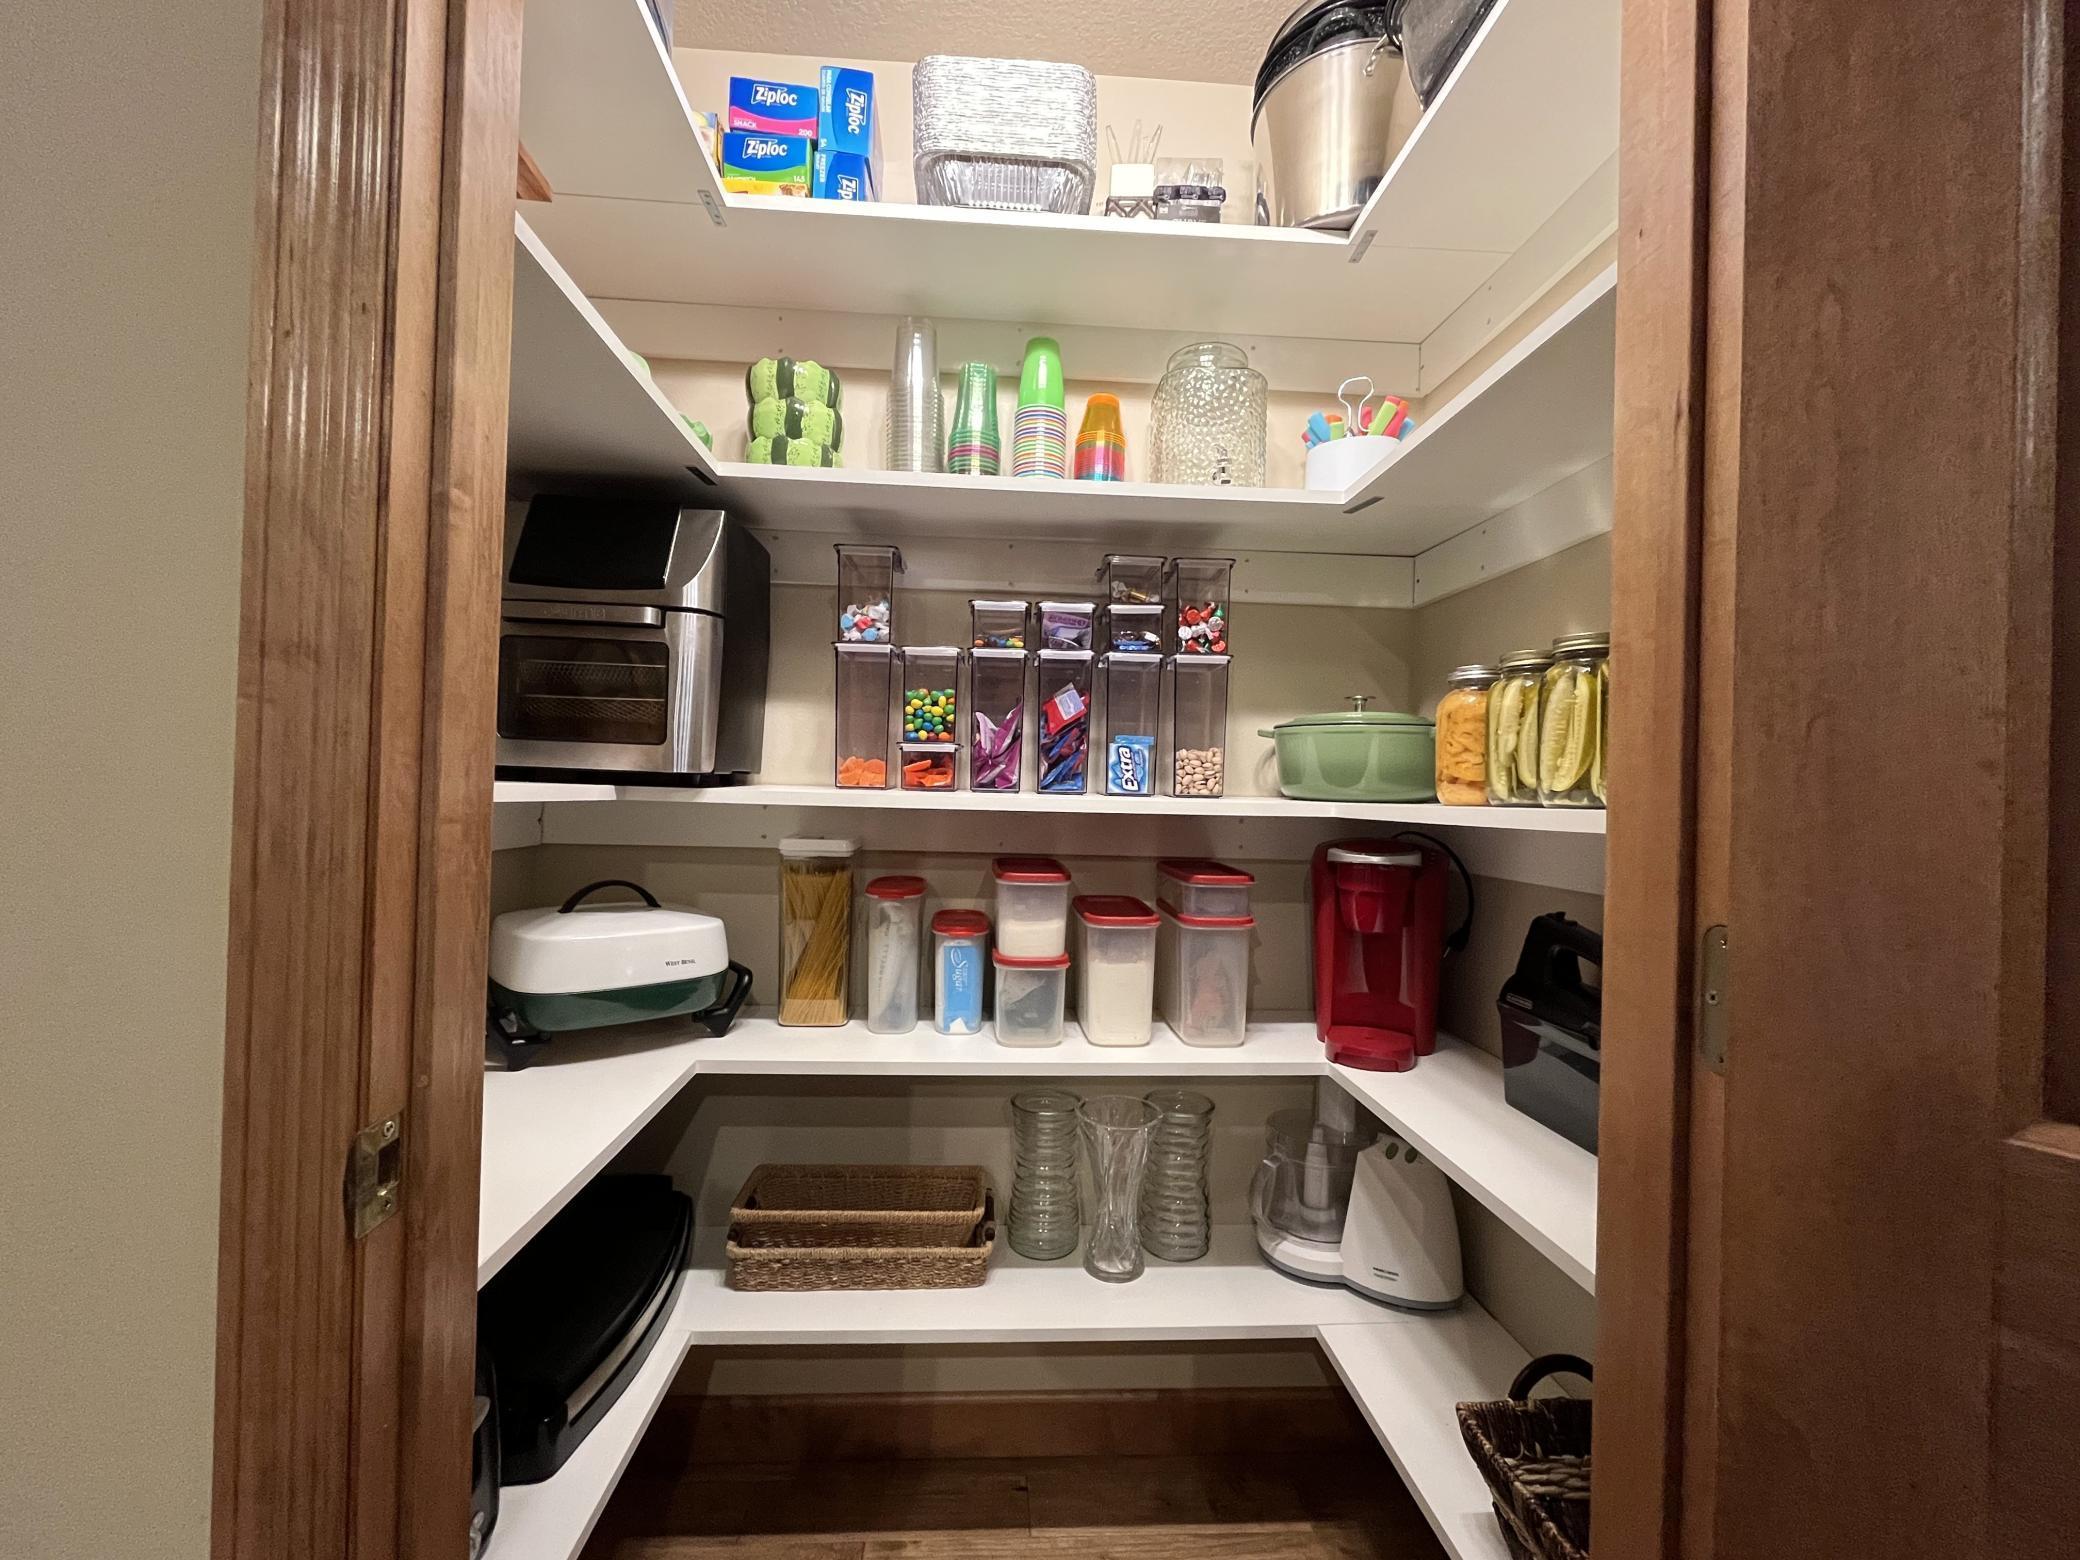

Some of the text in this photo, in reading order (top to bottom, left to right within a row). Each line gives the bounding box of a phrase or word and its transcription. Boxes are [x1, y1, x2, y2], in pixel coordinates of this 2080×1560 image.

[755, 86, 798, 106] Ziploc
[733, 119, 757, 128] SNACK
[845, 92, 865, 134] Ziploc
[798, 128, 813, 137] 200
[746, 140, 788, 159] Ziploc
[837, 178, 857, 201] Zip
[1118, 746, 1139, 791] Extra
[951, 949, 969, 992] Sugar
